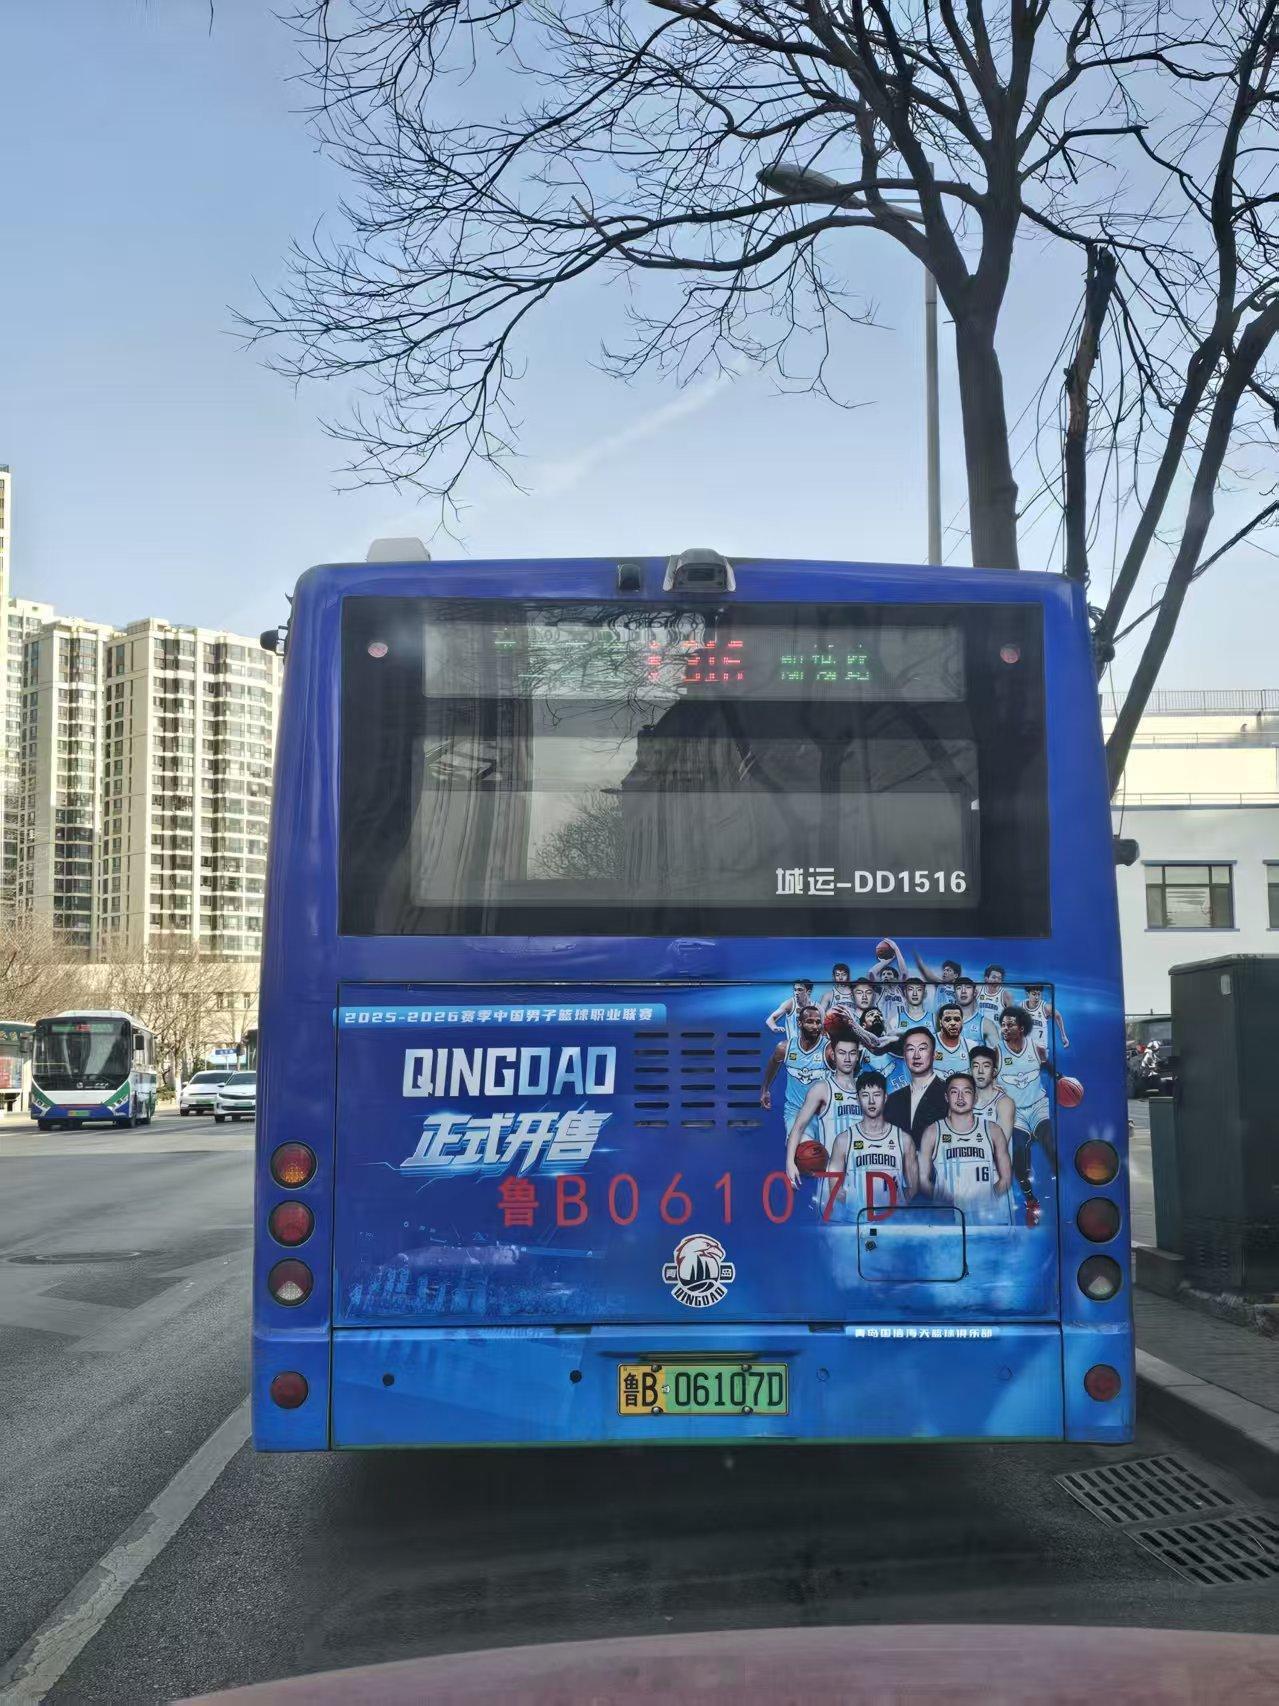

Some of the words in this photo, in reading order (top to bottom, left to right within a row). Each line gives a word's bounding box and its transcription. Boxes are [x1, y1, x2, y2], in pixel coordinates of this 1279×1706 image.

[775, 867, 967, 896] 城运-DD1516
[344, 1007, 653, 1024] 2025-2026赛季中国男子篮球职业联赛
[402, 1046, 617, 1097] QINGDAO
[400, 1109, 612, 1174] 正式开售
[975, 1166, 990, 1182] 16
[497, 1172, 898, 1227] 鲁B06107D
